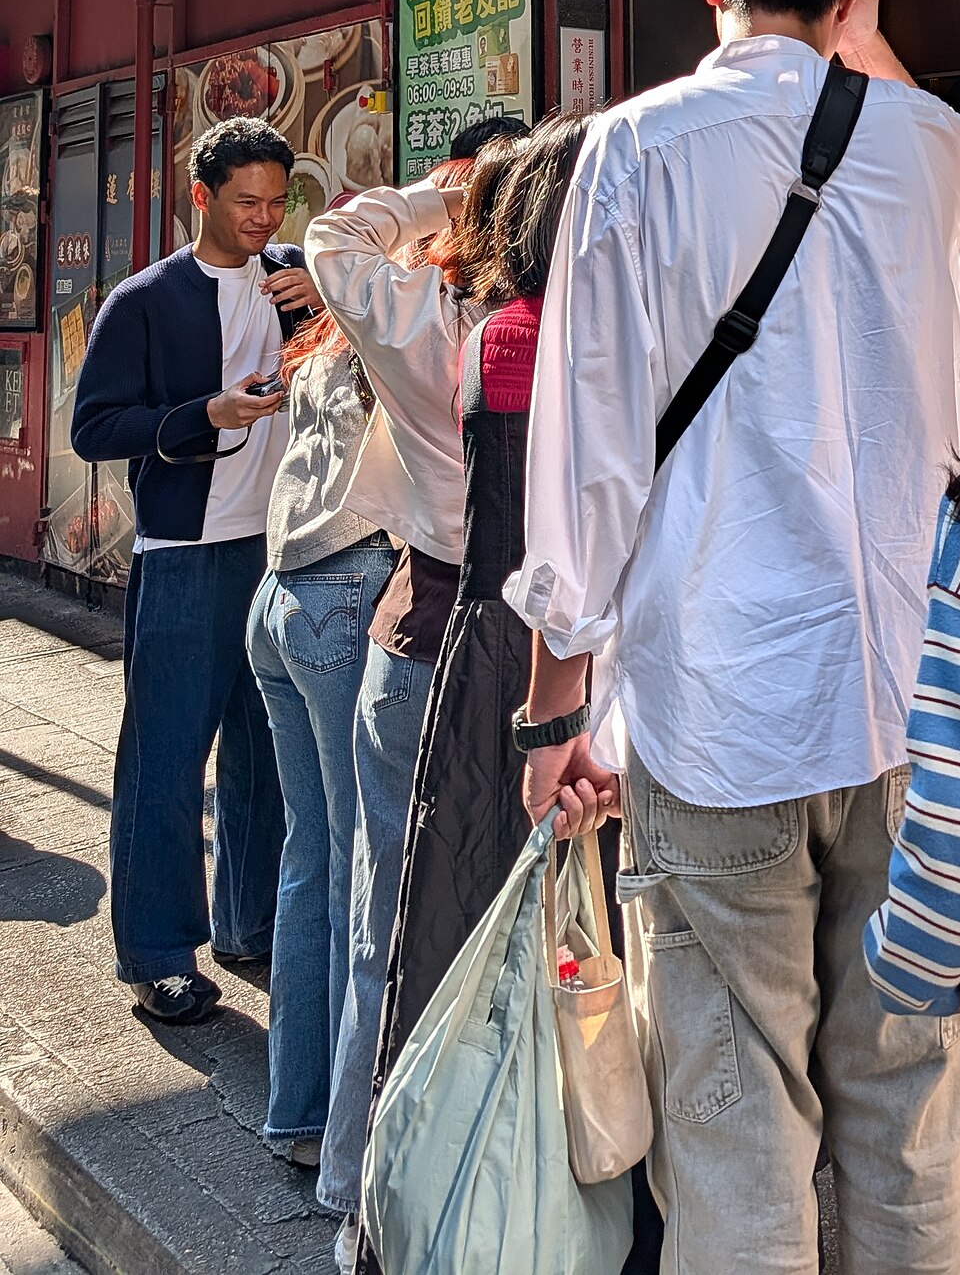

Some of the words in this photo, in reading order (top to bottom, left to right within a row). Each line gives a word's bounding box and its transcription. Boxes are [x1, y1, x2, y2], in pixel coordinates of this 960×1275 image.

[407, 46, 472, 79] 早茶長者優惠
[571, 37, 584, 113] 營業時間
[407, 83, 436, 105] 06:00
[444, 76, 474, 99] 09:45
